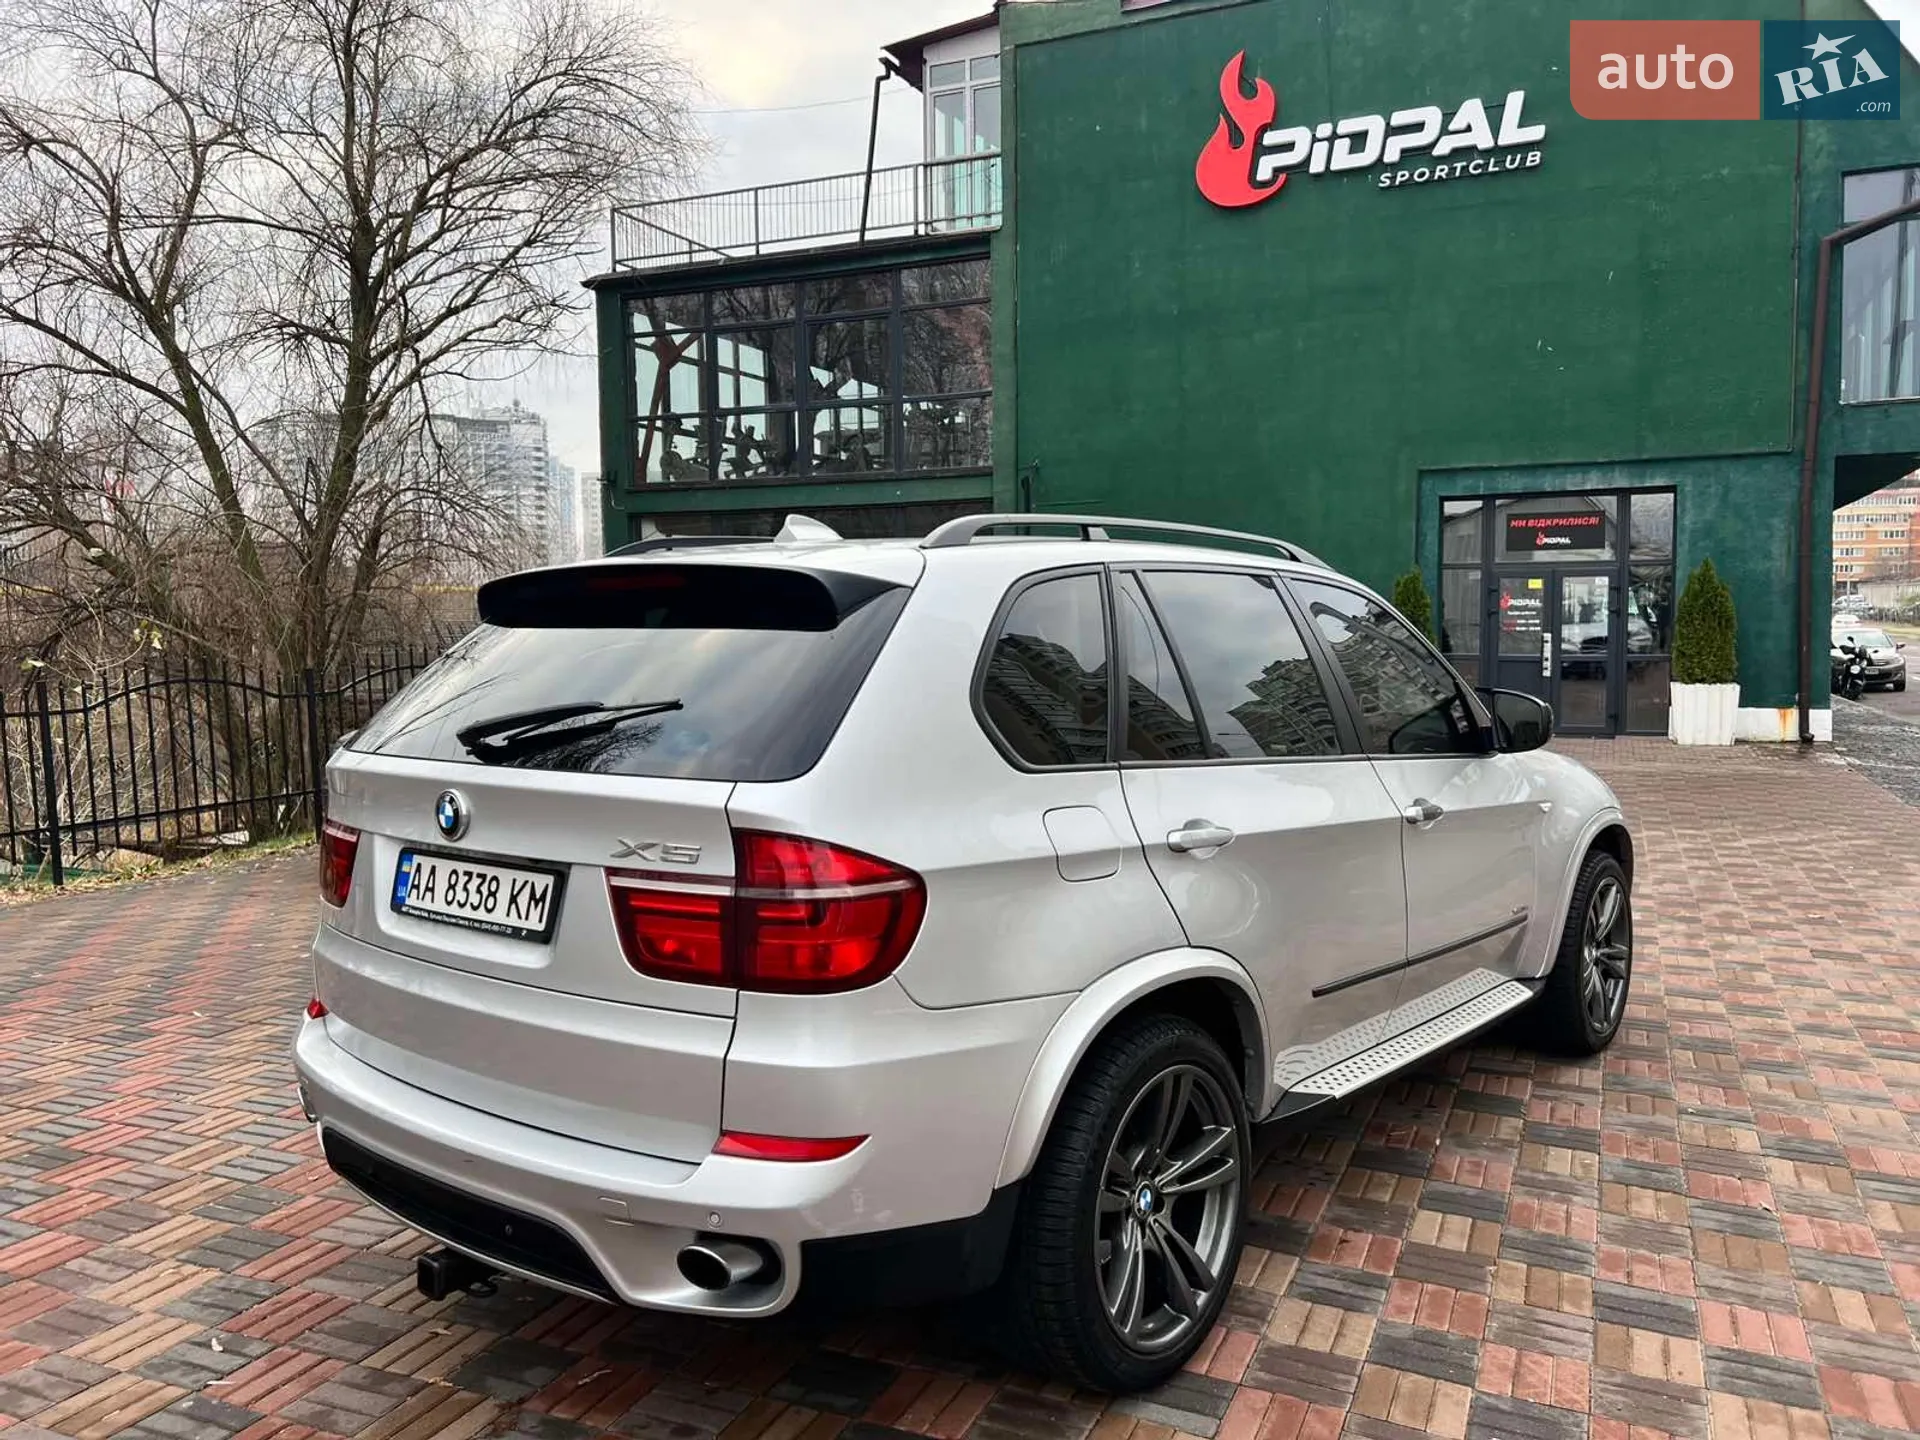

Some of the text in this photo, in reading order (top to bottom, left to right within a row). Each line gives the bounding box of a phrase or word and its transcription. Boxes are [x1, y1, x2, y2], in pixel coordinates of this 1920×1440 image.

[1378, 150, 1543, 188] SPORTCLUB
[610, 836, 702, 865] X5
[408, 862, 437, 904] AA
[444, 868, 501, 914] 8338
[506, 877, 550, 924] KM
